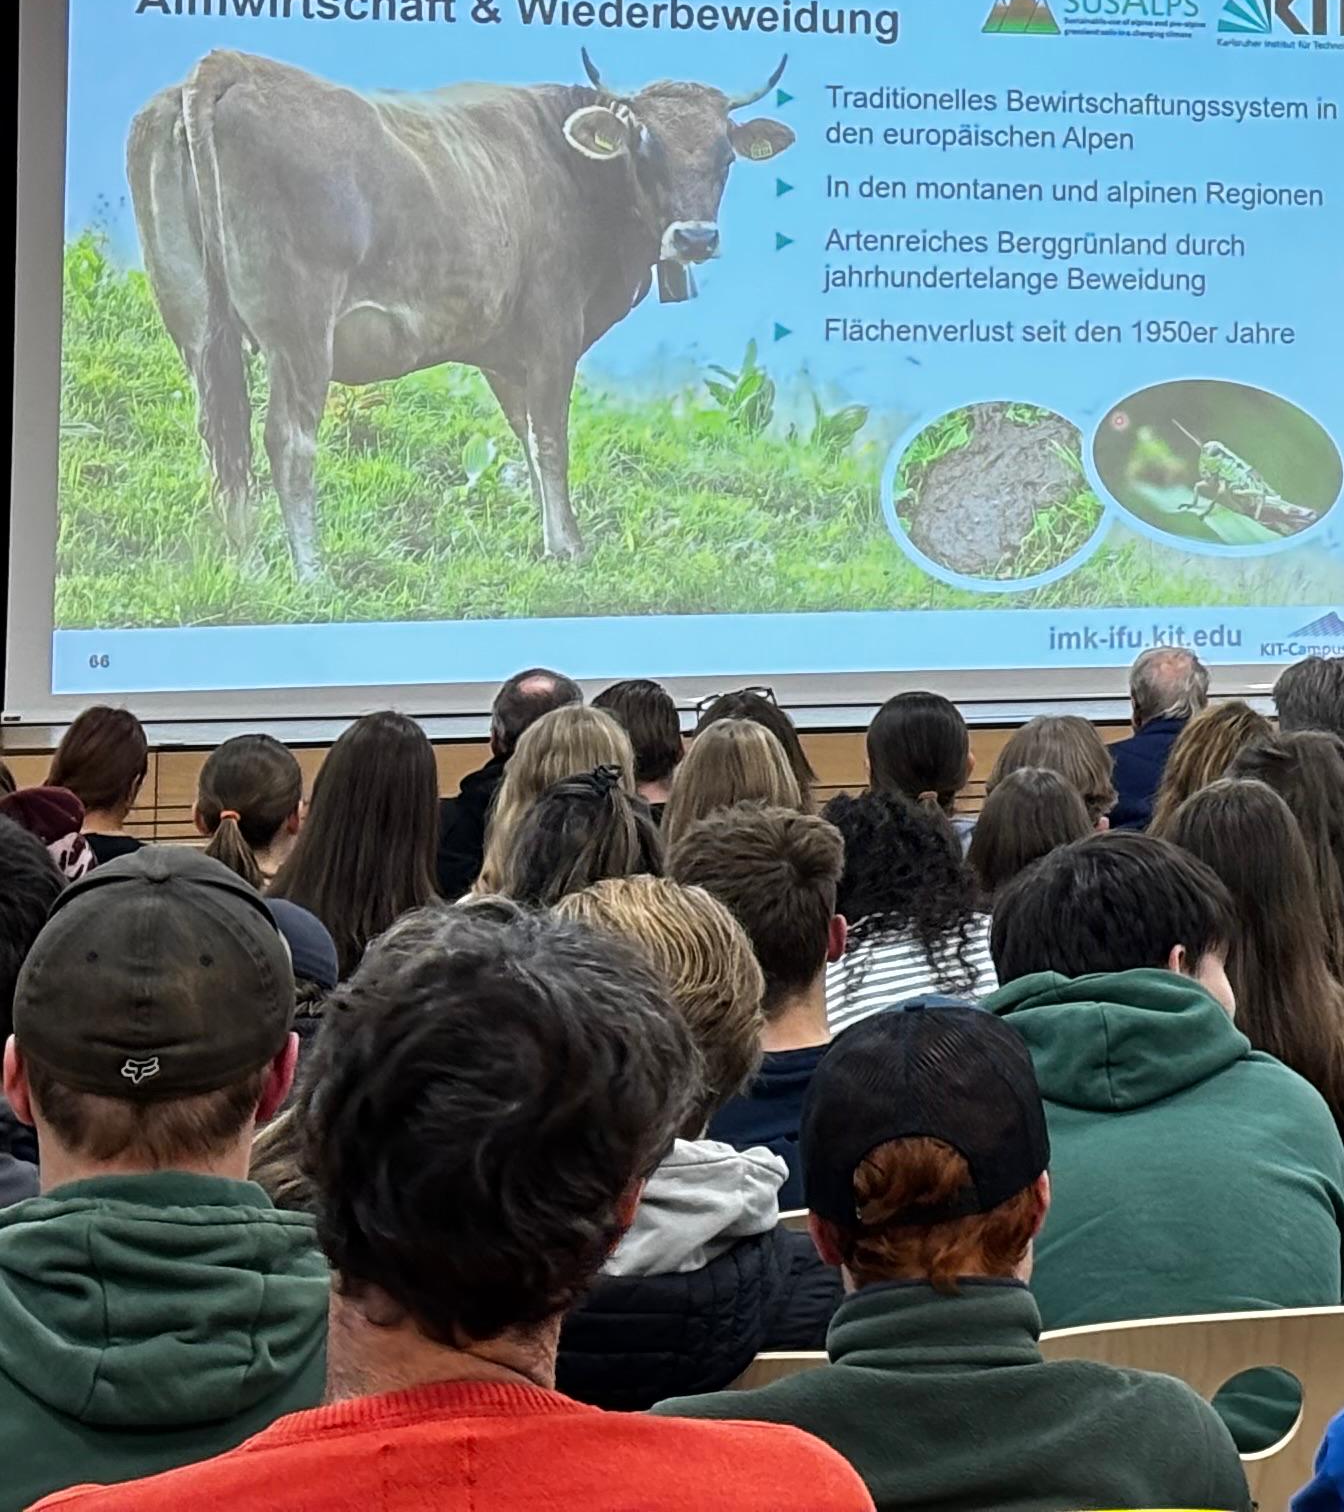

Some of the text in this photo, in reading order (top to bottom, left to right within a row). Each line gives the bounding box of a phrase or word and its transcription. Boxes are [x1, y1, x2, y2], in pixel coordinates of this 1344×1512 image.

[825, 85, 1338, 123] Traditionelles Bewirtschaftungssystem in
[825, 122, 1135, 156] den europäischen Alpen
[827, 175, 1324, 211] In den montanen und alpinen Regionen
[825, 228, 1246, 261] Artenreiches Berggrünland durch
[822, 264, 1207, 297] jahrhundertelange Beweidung
[825, 318, 1296, 345] Flächenverlust seit den 1950er Jahre
[1049, 624, 1243, 651] imk-ifu.kit.edu
